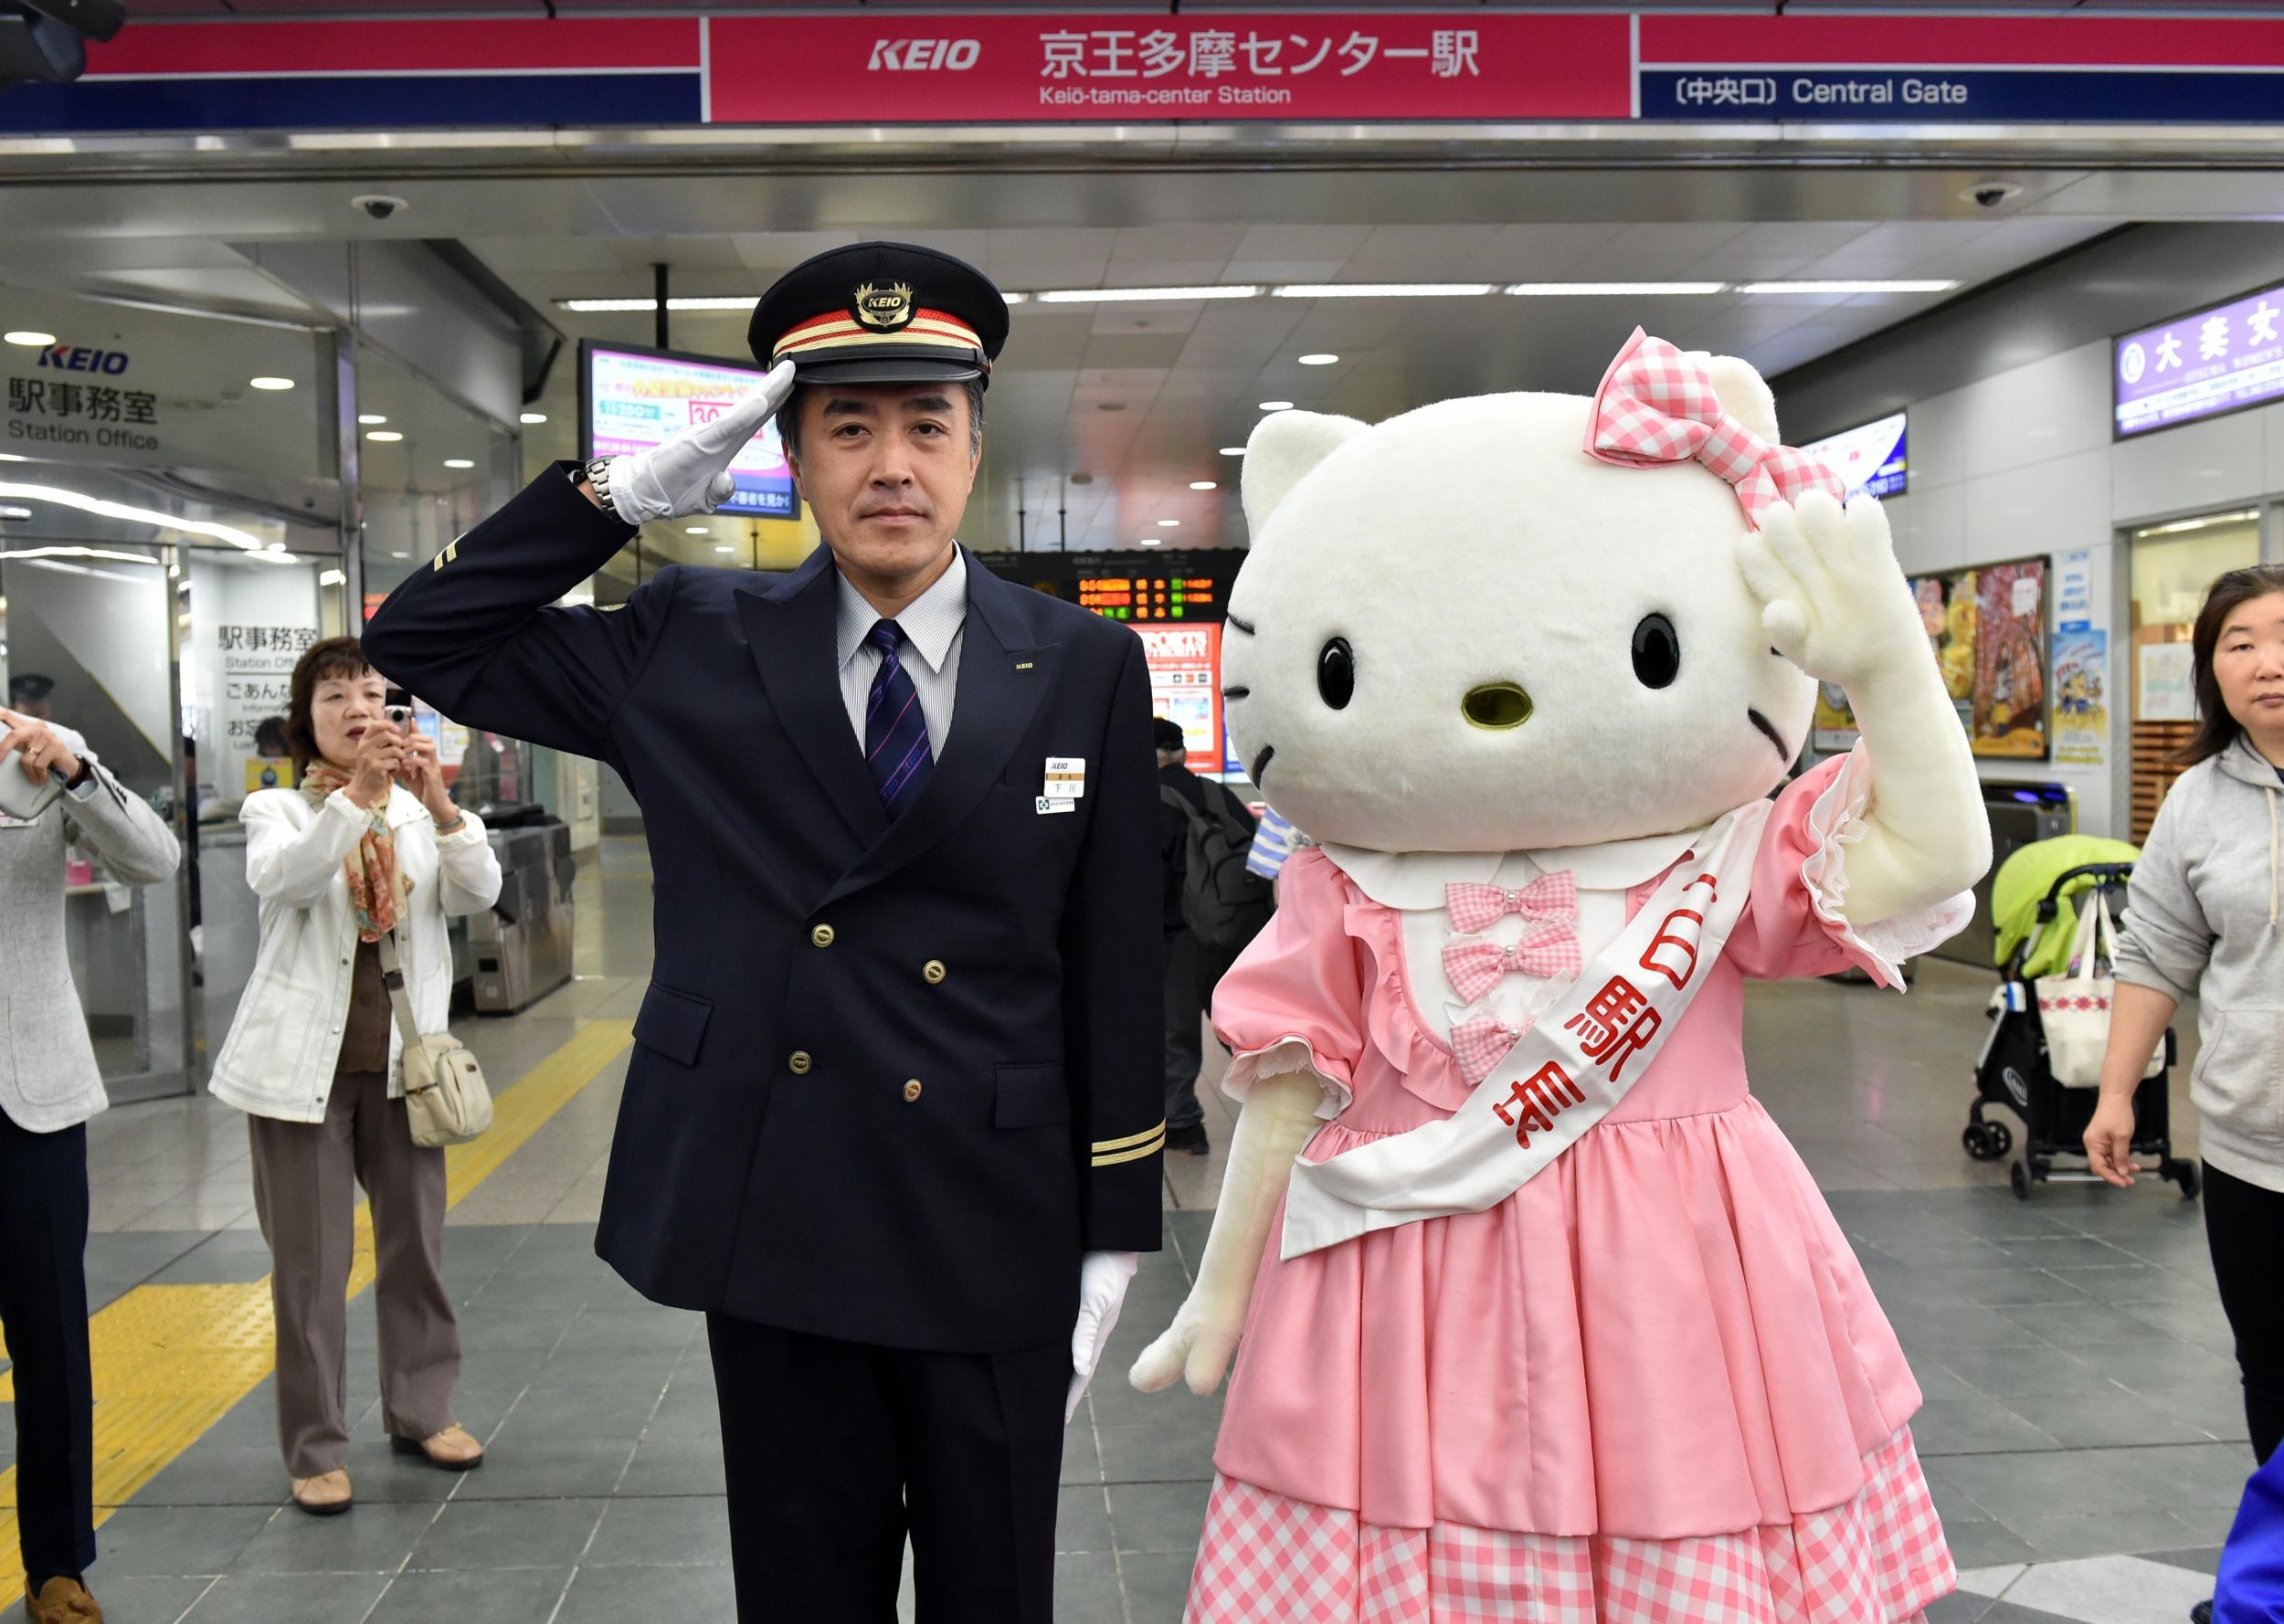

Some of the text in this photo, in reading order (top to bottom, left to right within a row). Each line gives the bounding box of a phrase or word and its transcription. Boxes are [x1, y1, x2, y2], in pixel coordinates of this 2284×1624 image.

[867, 39, 981, 70] KEIO
[1040, 29, 1480, 79] 京王多摩センター駅
[1218, 86, 1291, 104] Station
[1792, 79, 1893, 104] Central
[1901, 79, 1968, 104] Gate
[868, 297, 902, 308] KEIO
[37, 345, 129, 375] KEIO
[8, 377, 158, 426] 駅事務室
[8, 419, 159, 451] Station Office
[218, 626, 317, 651] 駅事務室
[226, 656, 271, 669] Station
[1016, 662, 1033, 670] KEIO
[1052, 762, 1067, 770] KEIO
